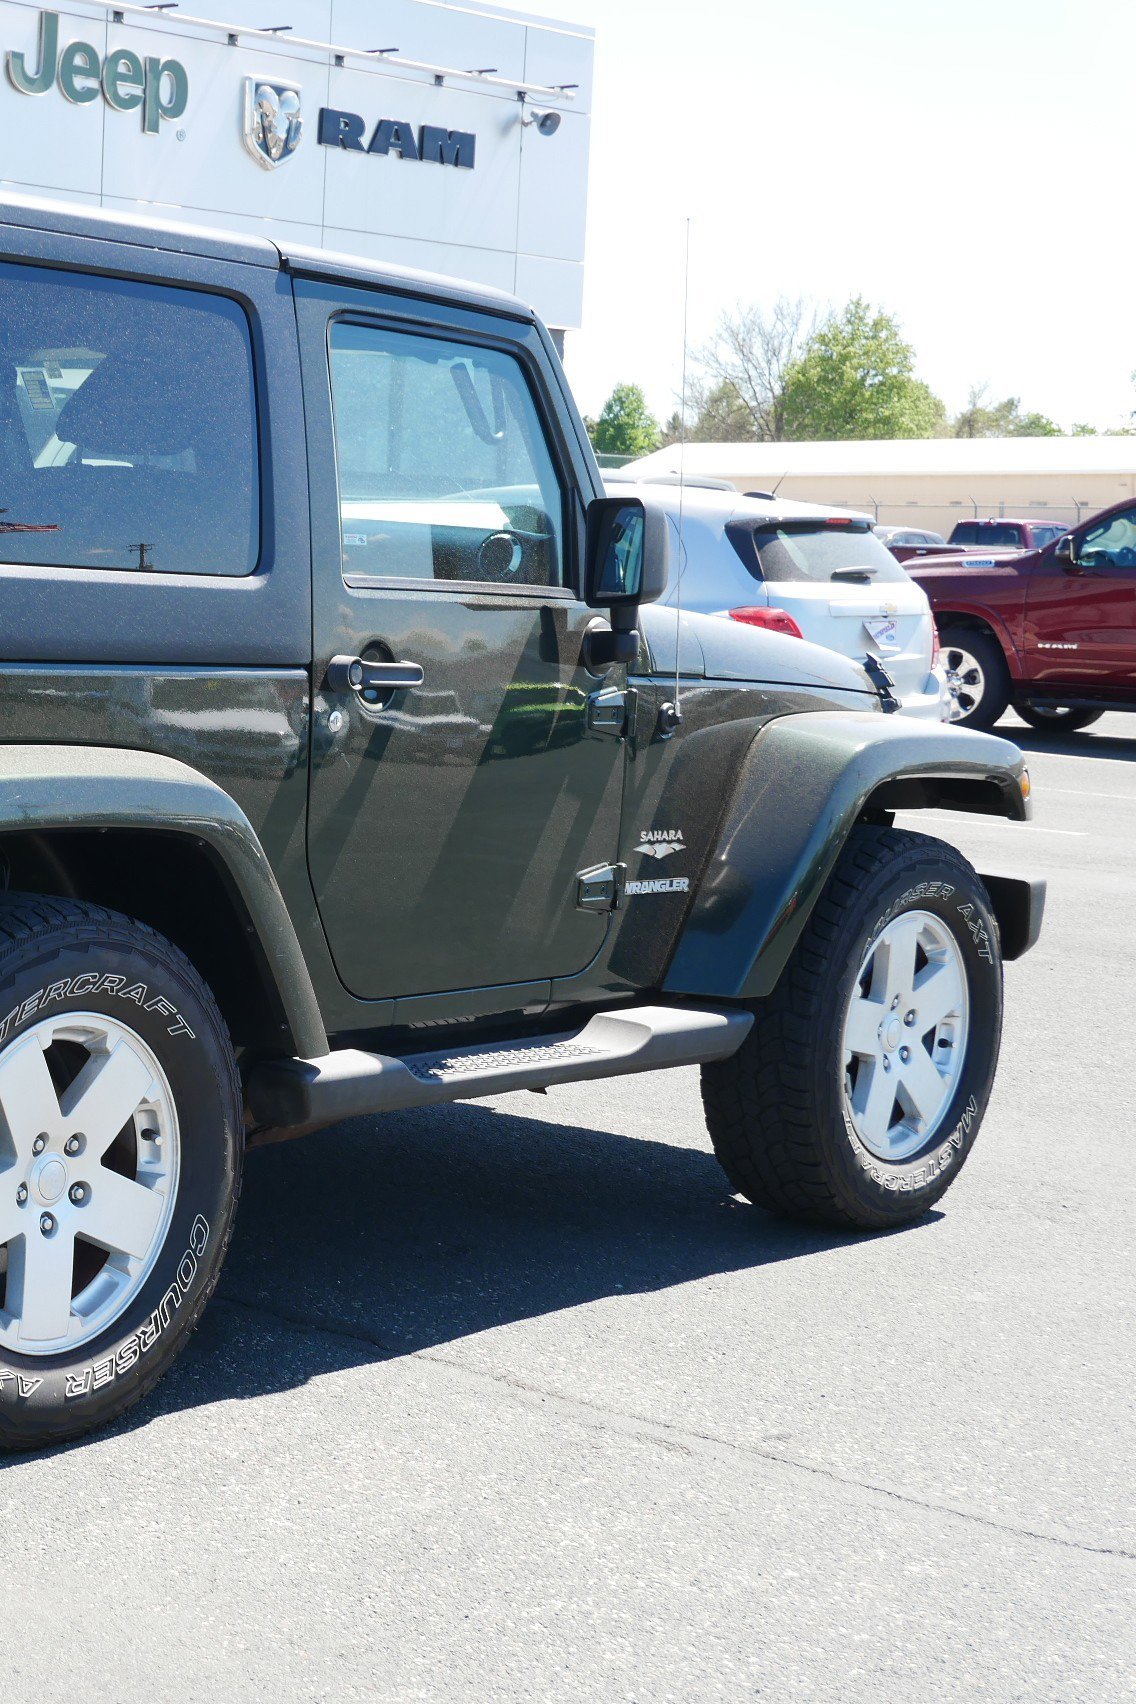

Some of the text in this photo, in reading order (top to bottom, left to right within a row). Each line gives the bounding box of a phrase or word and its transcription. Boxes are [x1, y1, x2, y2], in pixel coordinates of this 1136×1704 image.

[6, 9, 189, 135] Jeep
[318, 106, 476, 169] RAM
[640, 829, 683, 842] SAHARA
[625, 877, 689, 895] WRANGLER
[957, 903, 994, 965] AXT
[842, 1094, 978, 1191] MASTERCRAFT
[65, 1213, 210, 1398] COURSER
